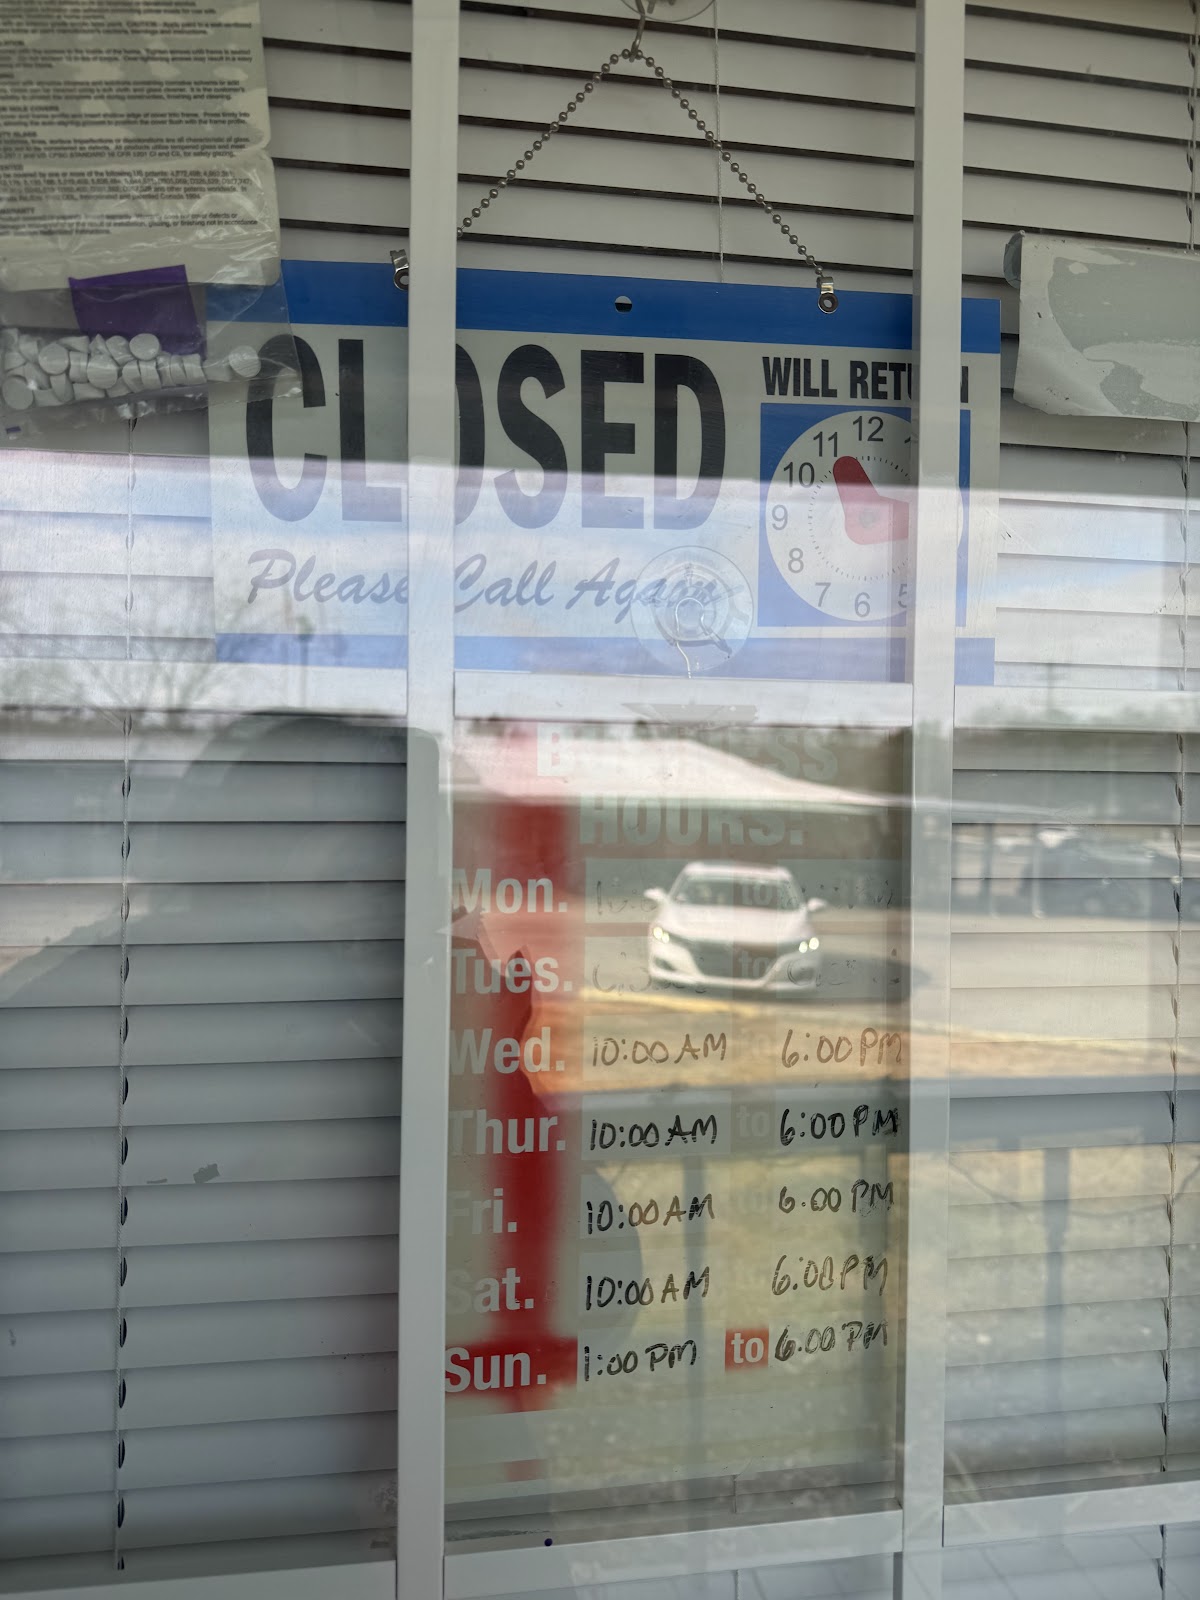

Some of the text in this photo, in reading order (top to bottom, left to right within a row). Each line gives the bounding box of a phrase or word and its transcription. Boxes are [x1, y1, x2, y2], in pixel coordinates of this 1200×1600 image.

[762, 356, 969, 403] WILL RET
[813, 431, 839, 458] 11
[853, 416, 884, 442] 12
[783, 462, 815, 488] 10
[772, 505, 788, 530] 9
[788, 548, 804, 574] 8
[247, 549, 720, 624] Please Call Again
[815, 582, 831, 607] 7
[854, 592, 871, 617] 6
[452, 868, 568, 914] Mon.
[452, 949, 573, 994] Tues.
[450, 1027, 565, 1075] Wed.
[592, 1036, 669, 1067] 10:00
[674, 1032, 727, 1064] AM
[782, 1029, 852, 1068] 6:00
[860, 1027, 902, 1067] PM
[449, 1109, 566, 1155] Thur.
[590, 1114, 718, 1151] 10:00 AM
[780, 1104, 900, 1146] 6:00 PM
[448, 1188, 517, 1235] Fri.
[587, 1193, 715, 1235] 10:00 AM
[851, 1178, 894, 1213] PM
[446, 1267, 534, 1315] Sat.
[586, 1275, 654, 1311] 10:00
[660, 1266, 710, 1304] AM
[731, 1332, 763, 1364] to
[841, 1320, 888, 1352] PM
[445, 1347, 547, 1393] Sun.
[584, 1339, 698, 1382] 1:00 PM
